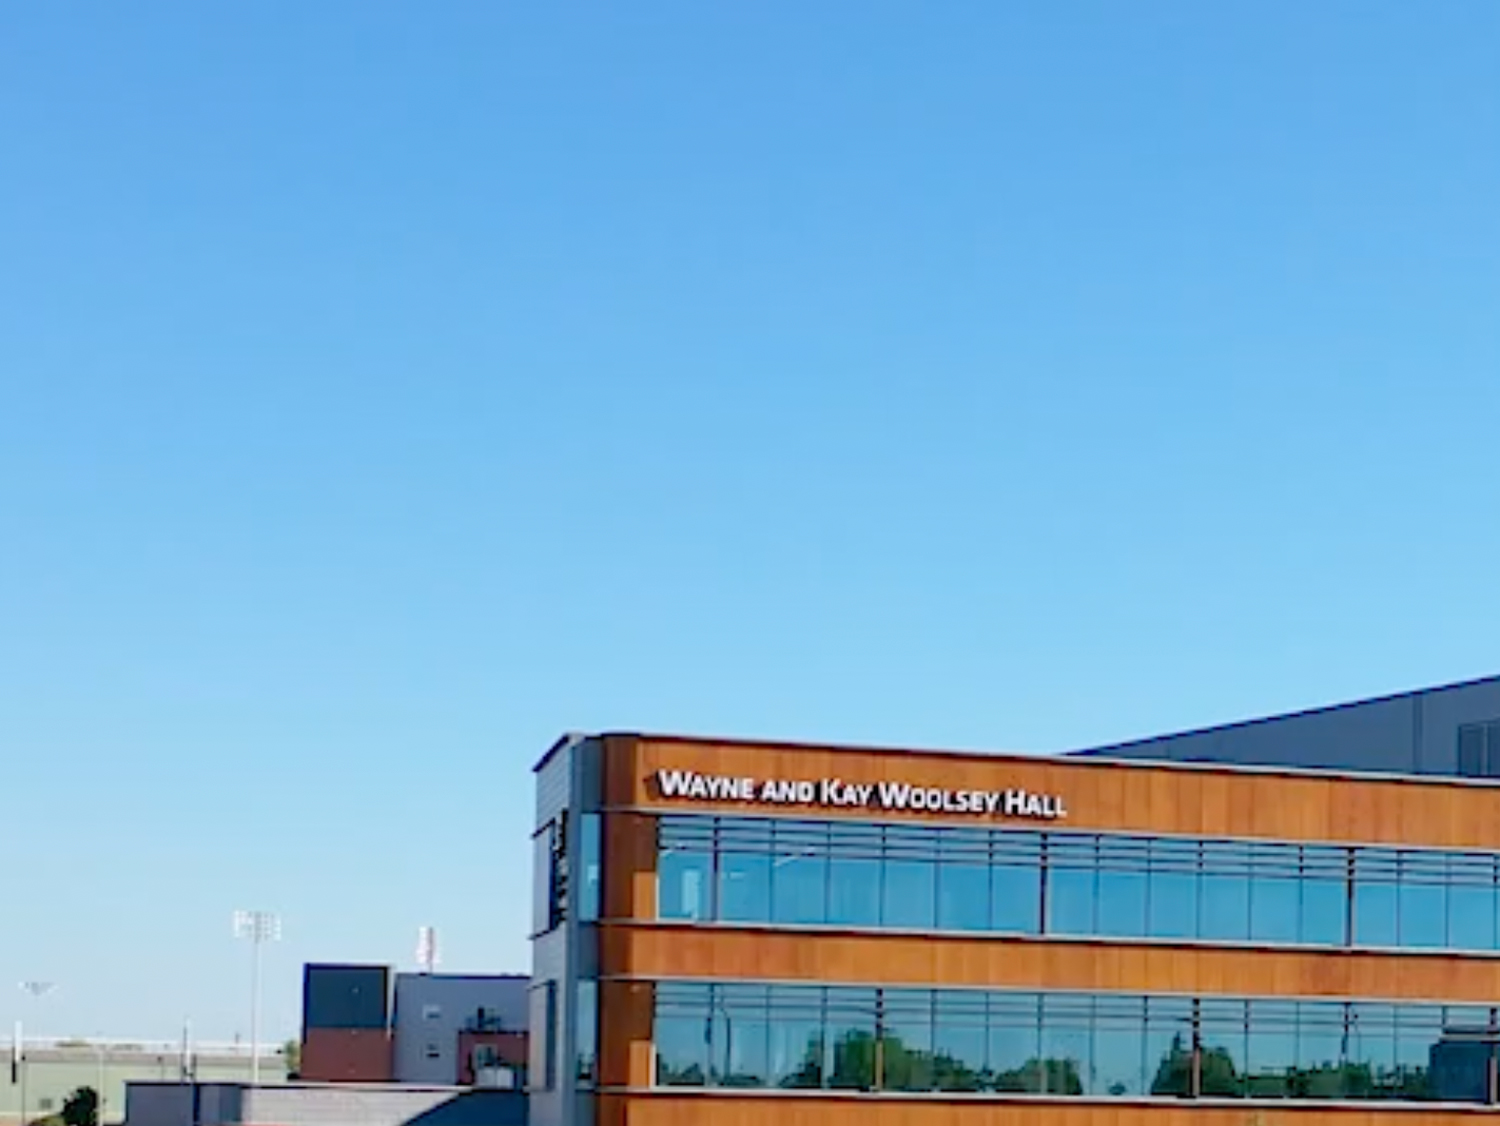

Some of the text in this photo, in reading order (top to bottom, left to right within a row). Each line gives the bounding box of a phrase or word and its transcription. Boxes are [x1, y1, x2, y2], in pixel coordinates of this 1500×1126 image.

[659, 770, 1067, 817] WAYNE AND KAY WOOLSEY HALL
